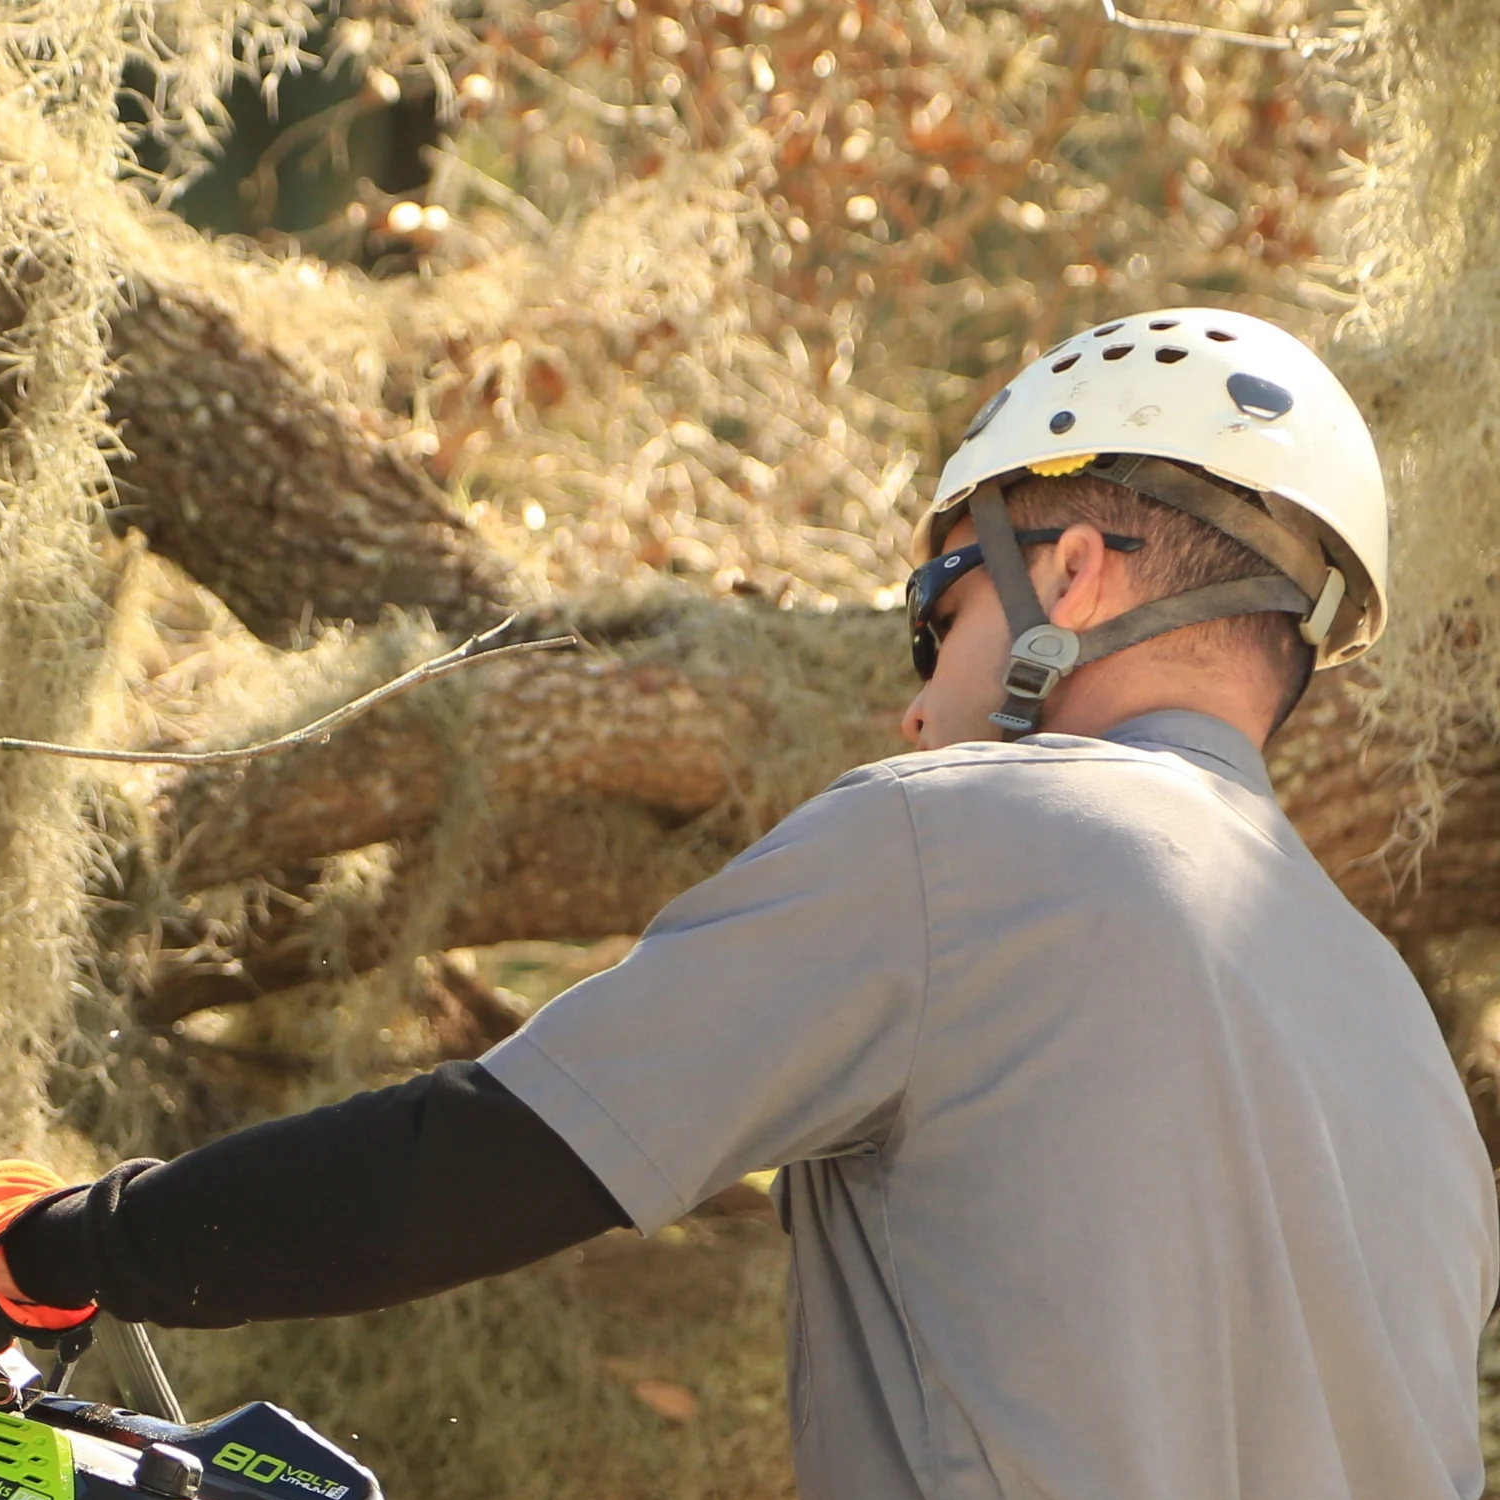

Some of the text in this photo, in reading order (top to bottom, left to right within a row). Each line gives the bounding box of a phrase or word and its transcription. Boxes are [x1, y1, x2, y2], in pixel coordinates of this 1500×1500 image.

[212, 1442, 287, 1483] 80
[279, 1473, 329, 1496] LITHIUM
[287, 1465, 340, 1489] VOLT
